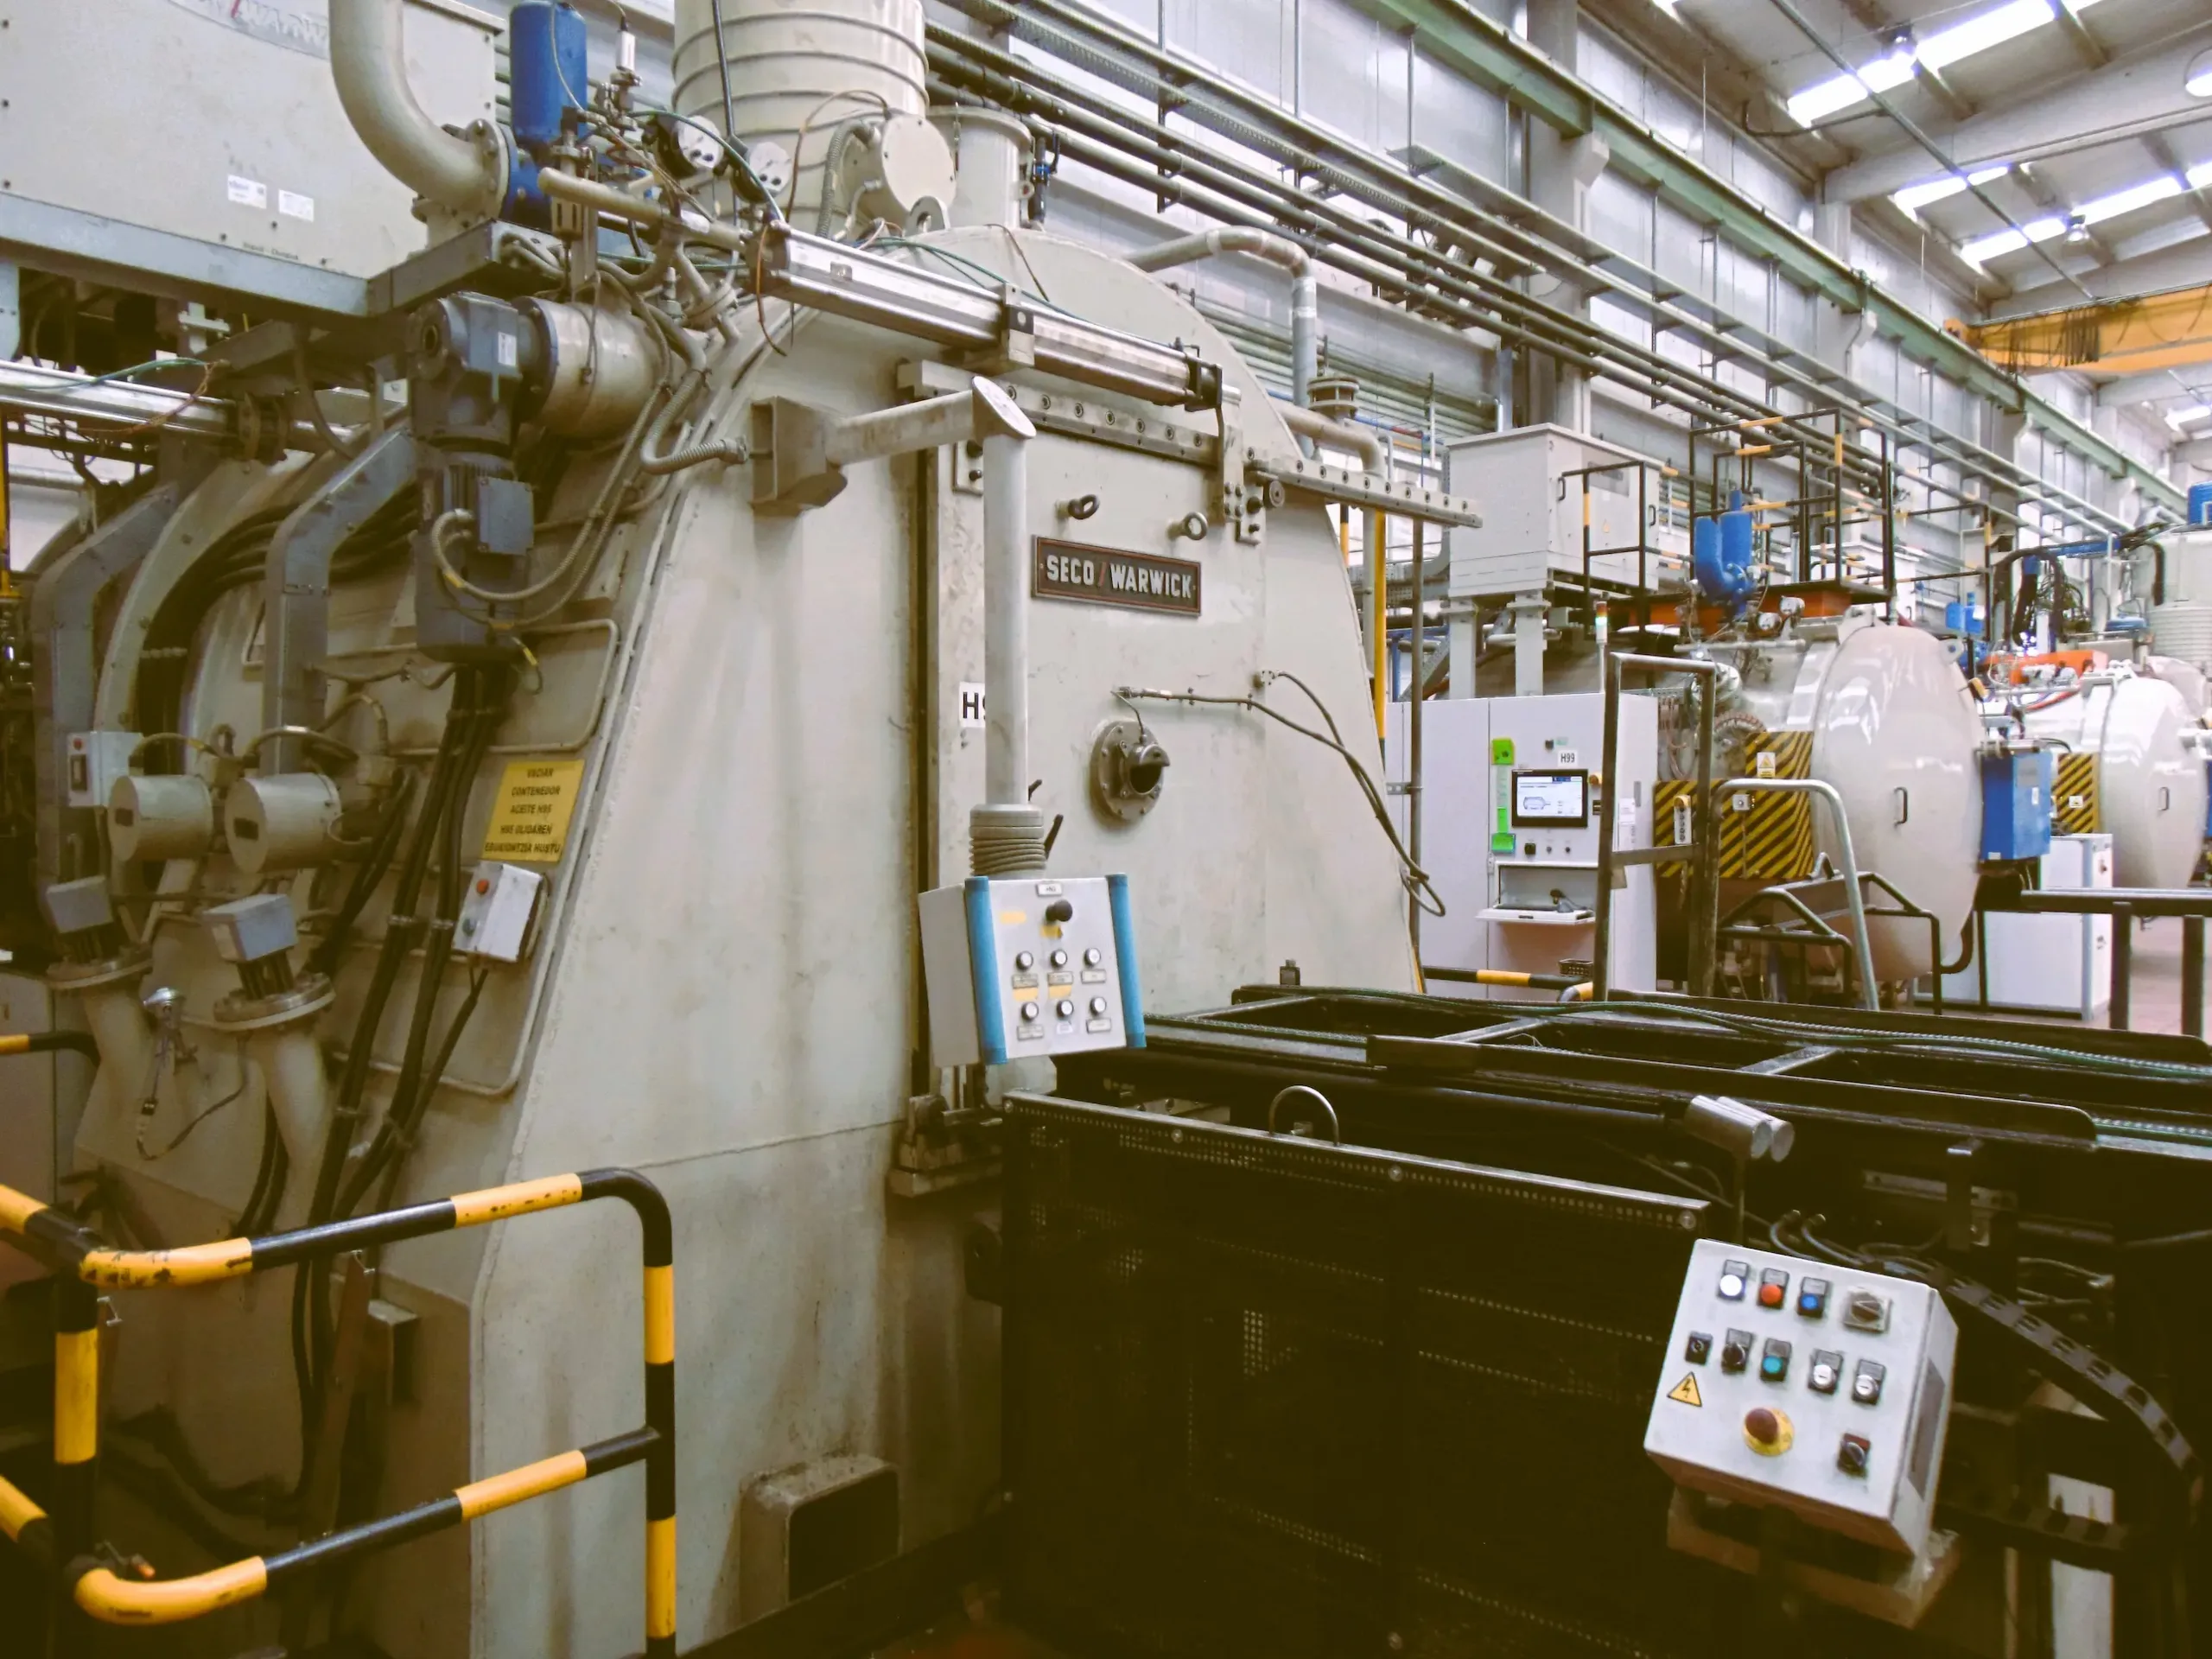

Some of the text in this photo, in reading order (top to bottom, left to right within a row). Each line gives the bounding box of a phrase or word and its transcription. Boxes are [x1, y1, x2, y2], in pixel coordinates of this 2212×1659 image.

[963, 691, 986, 721] H
[1560, 753, 1575, 763] H99
[527, 767, 554, 778] VACIAR
[512, 785, 561, 797] CONTENEDOR
[510, 804, 536, 814] ACEITE
